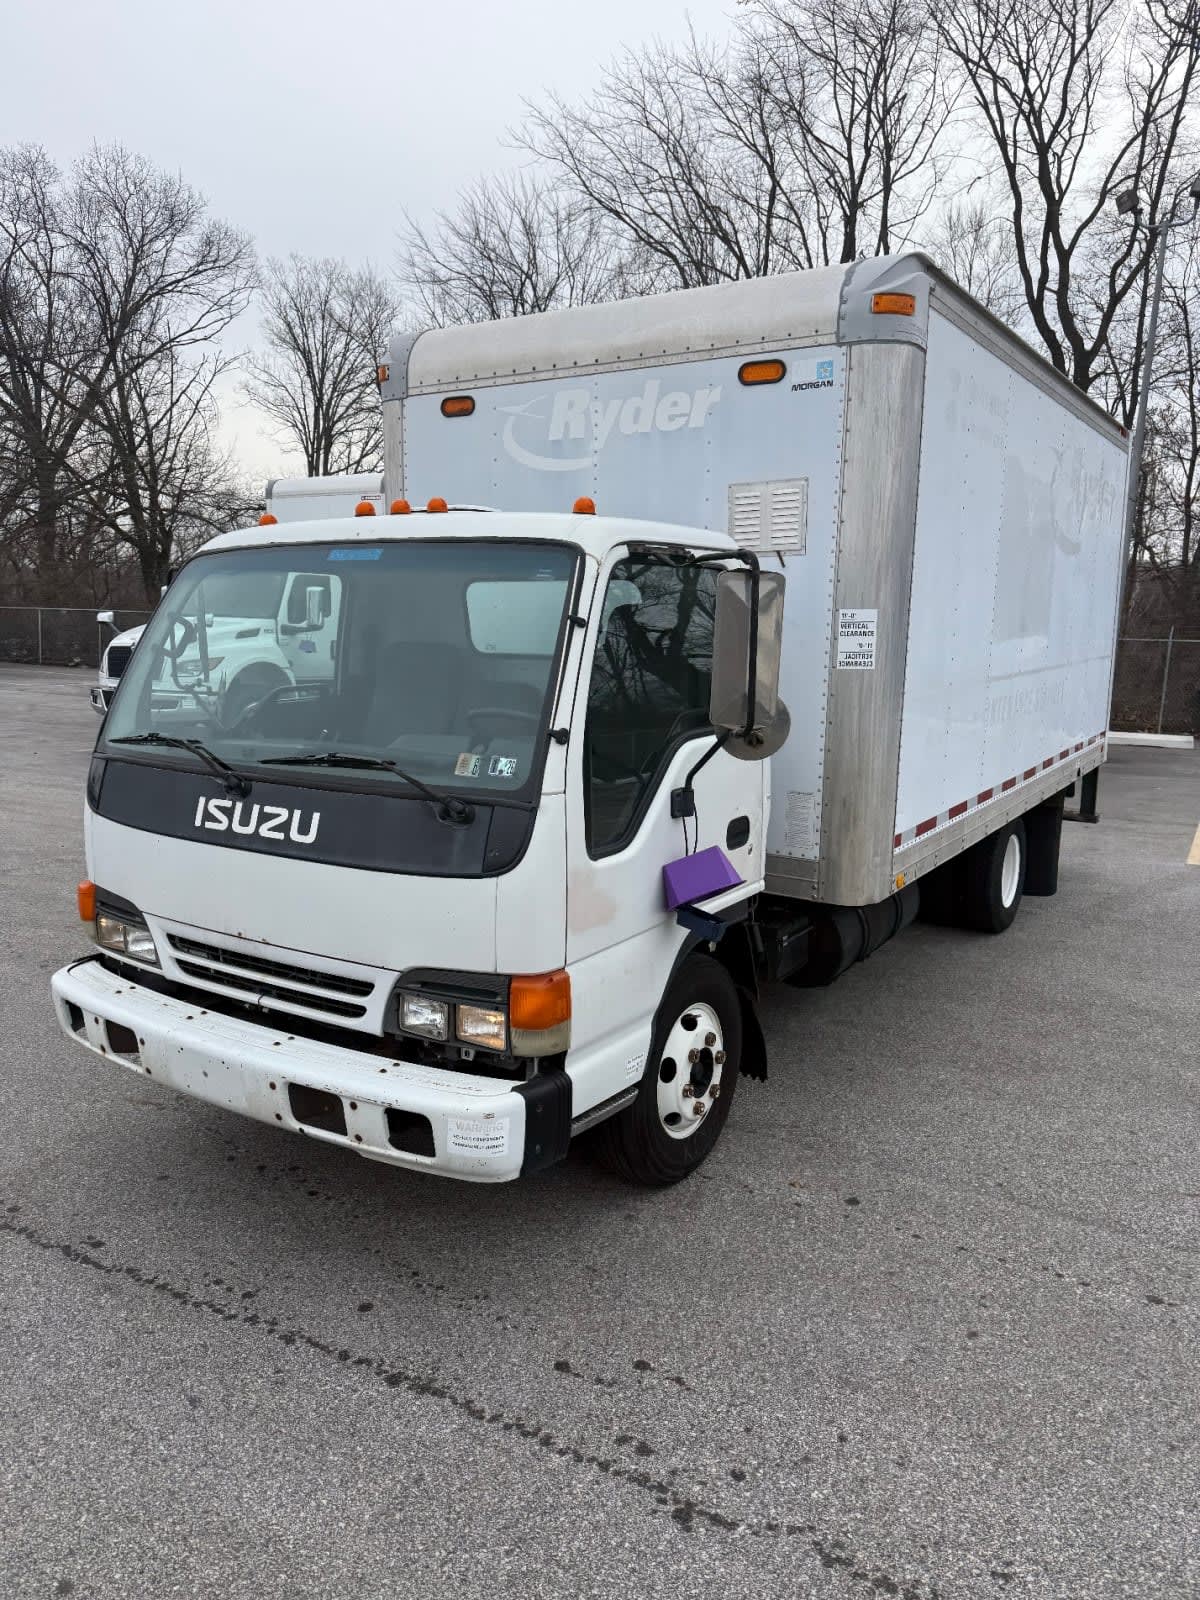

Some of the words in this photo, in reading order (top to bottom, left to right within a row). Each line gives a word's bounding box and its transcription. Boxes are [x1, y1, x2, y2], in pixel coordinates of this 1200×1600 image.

[791, 380, 834, 391] MORGAN
[548, 379, 722, 449] Ryder
[194, 796, 321, 844] ISUZU
